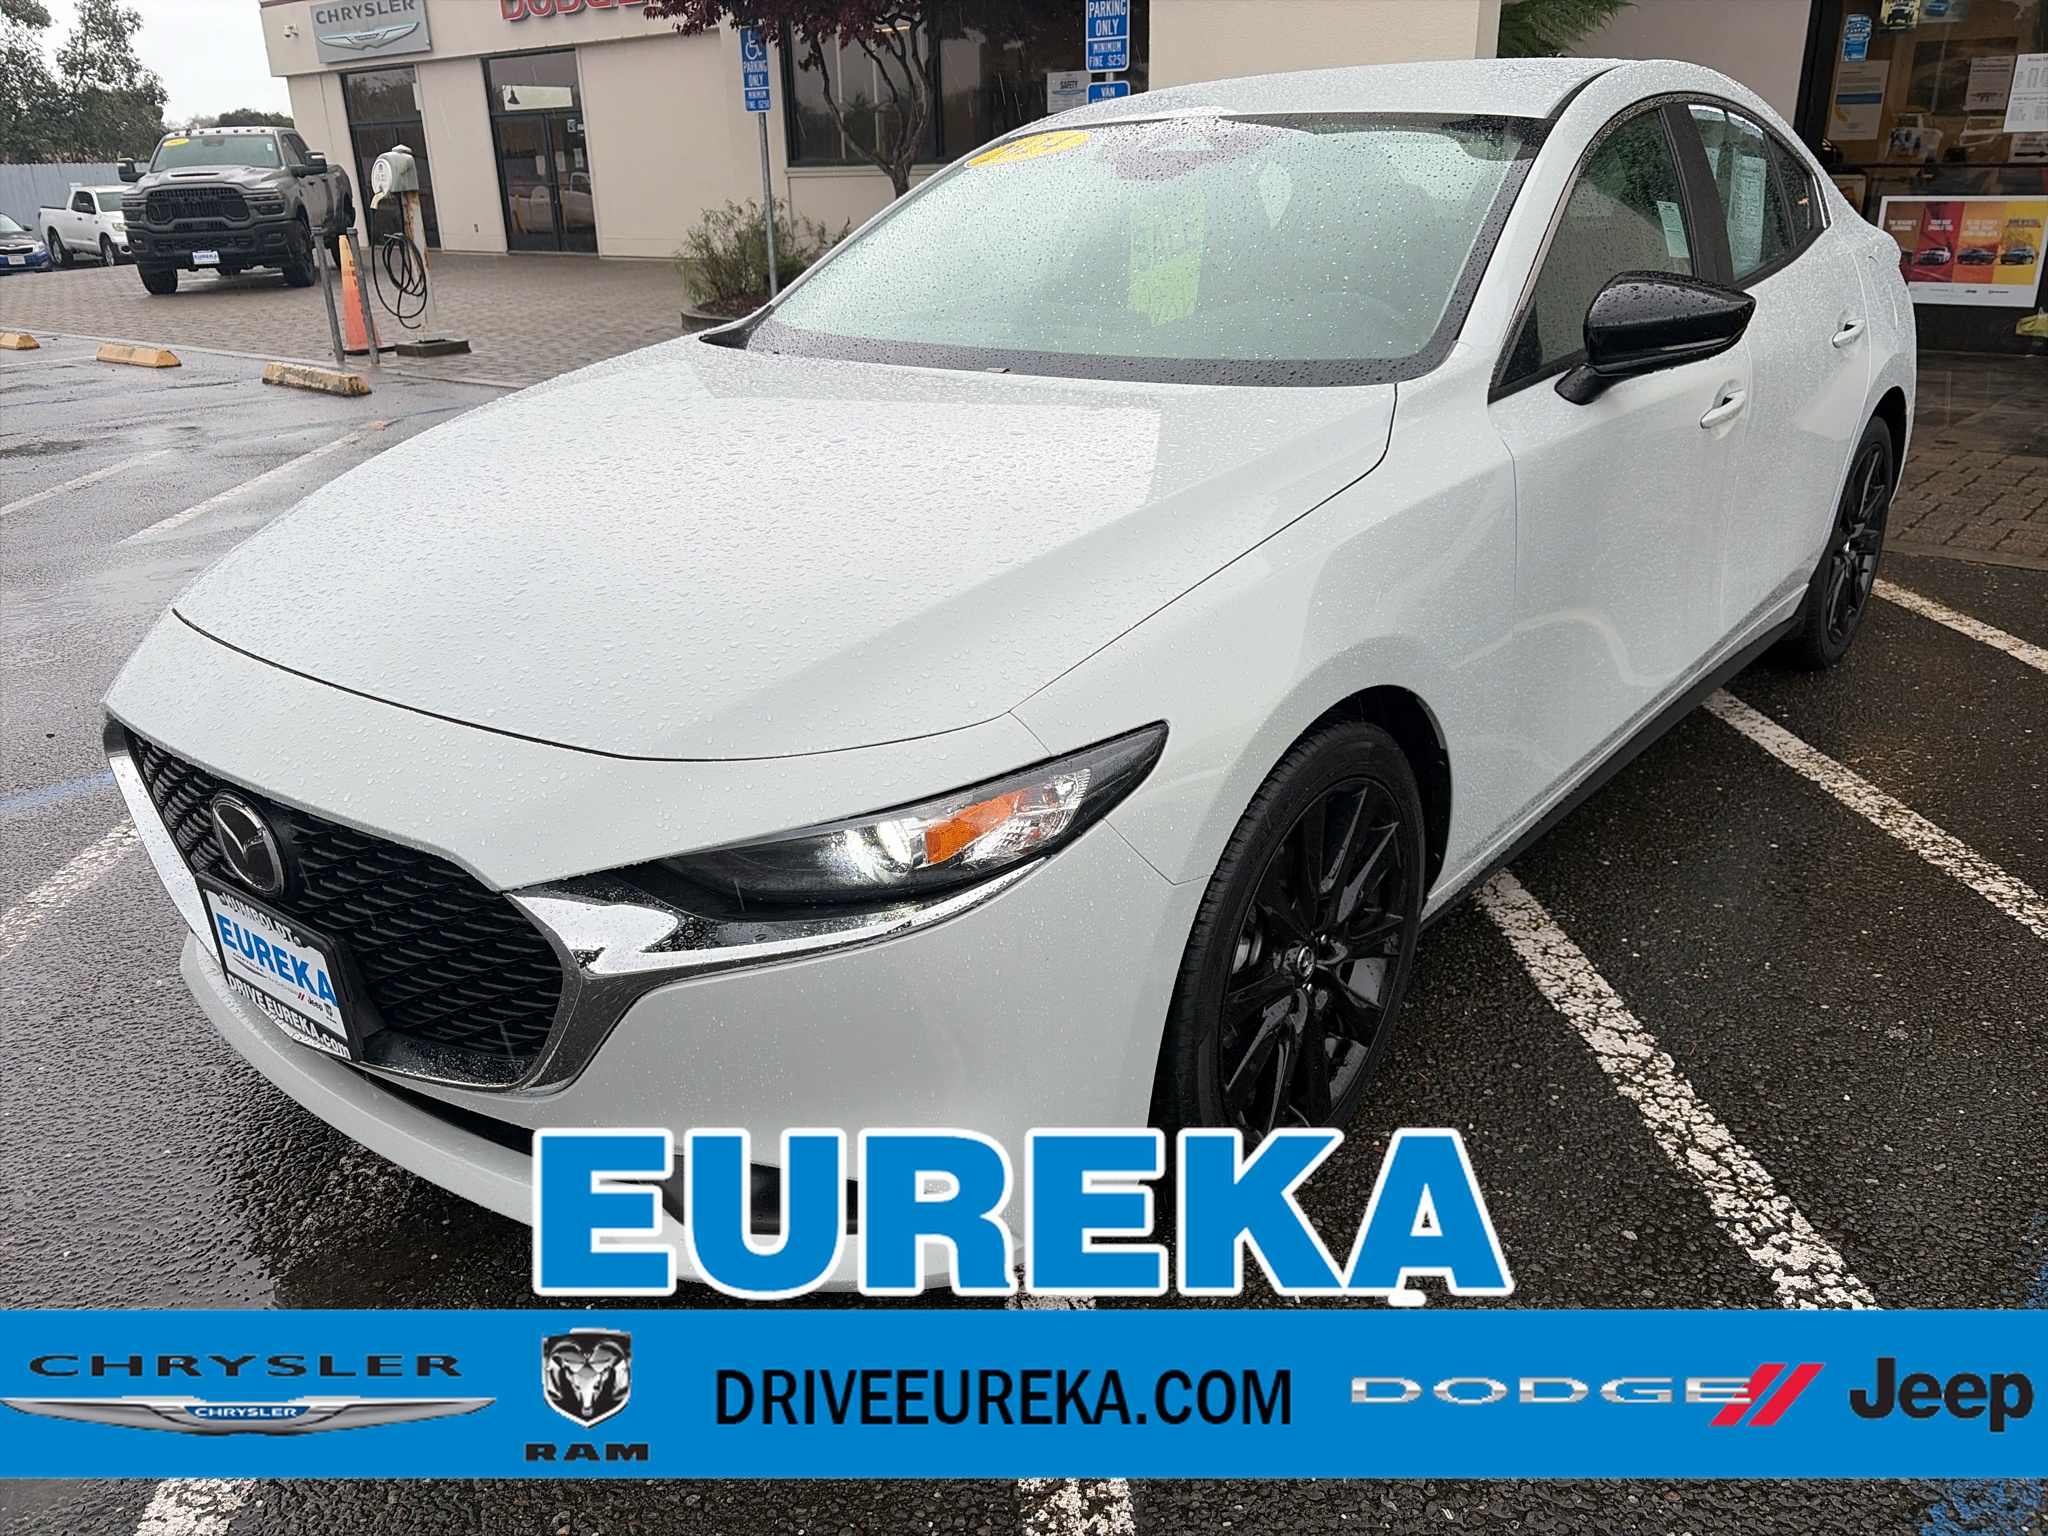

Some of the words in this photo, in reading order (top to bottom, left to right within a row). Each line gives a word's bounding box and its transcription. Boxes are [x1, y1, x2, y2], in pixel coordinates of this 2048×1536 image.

[316, 0, 415, 24] CHRYSLER
[1088, 0, 1126, 18] PARKING
[1095, 19, 1119, 36] ONLY
[1092, 40, 1122, 54] MINIMUM
[743, 60, 768, 73] PARKING
[1089, 56, 1104, 67] FINE
[1107, 54, 1126, 66] $250
[748, 74, 764, 87] ONLY
[1060, 80, 1078, 90] SAFETY
[1101, 86, 1116, 97] VAN
[216, 913, 339, 1008] EUREKA
